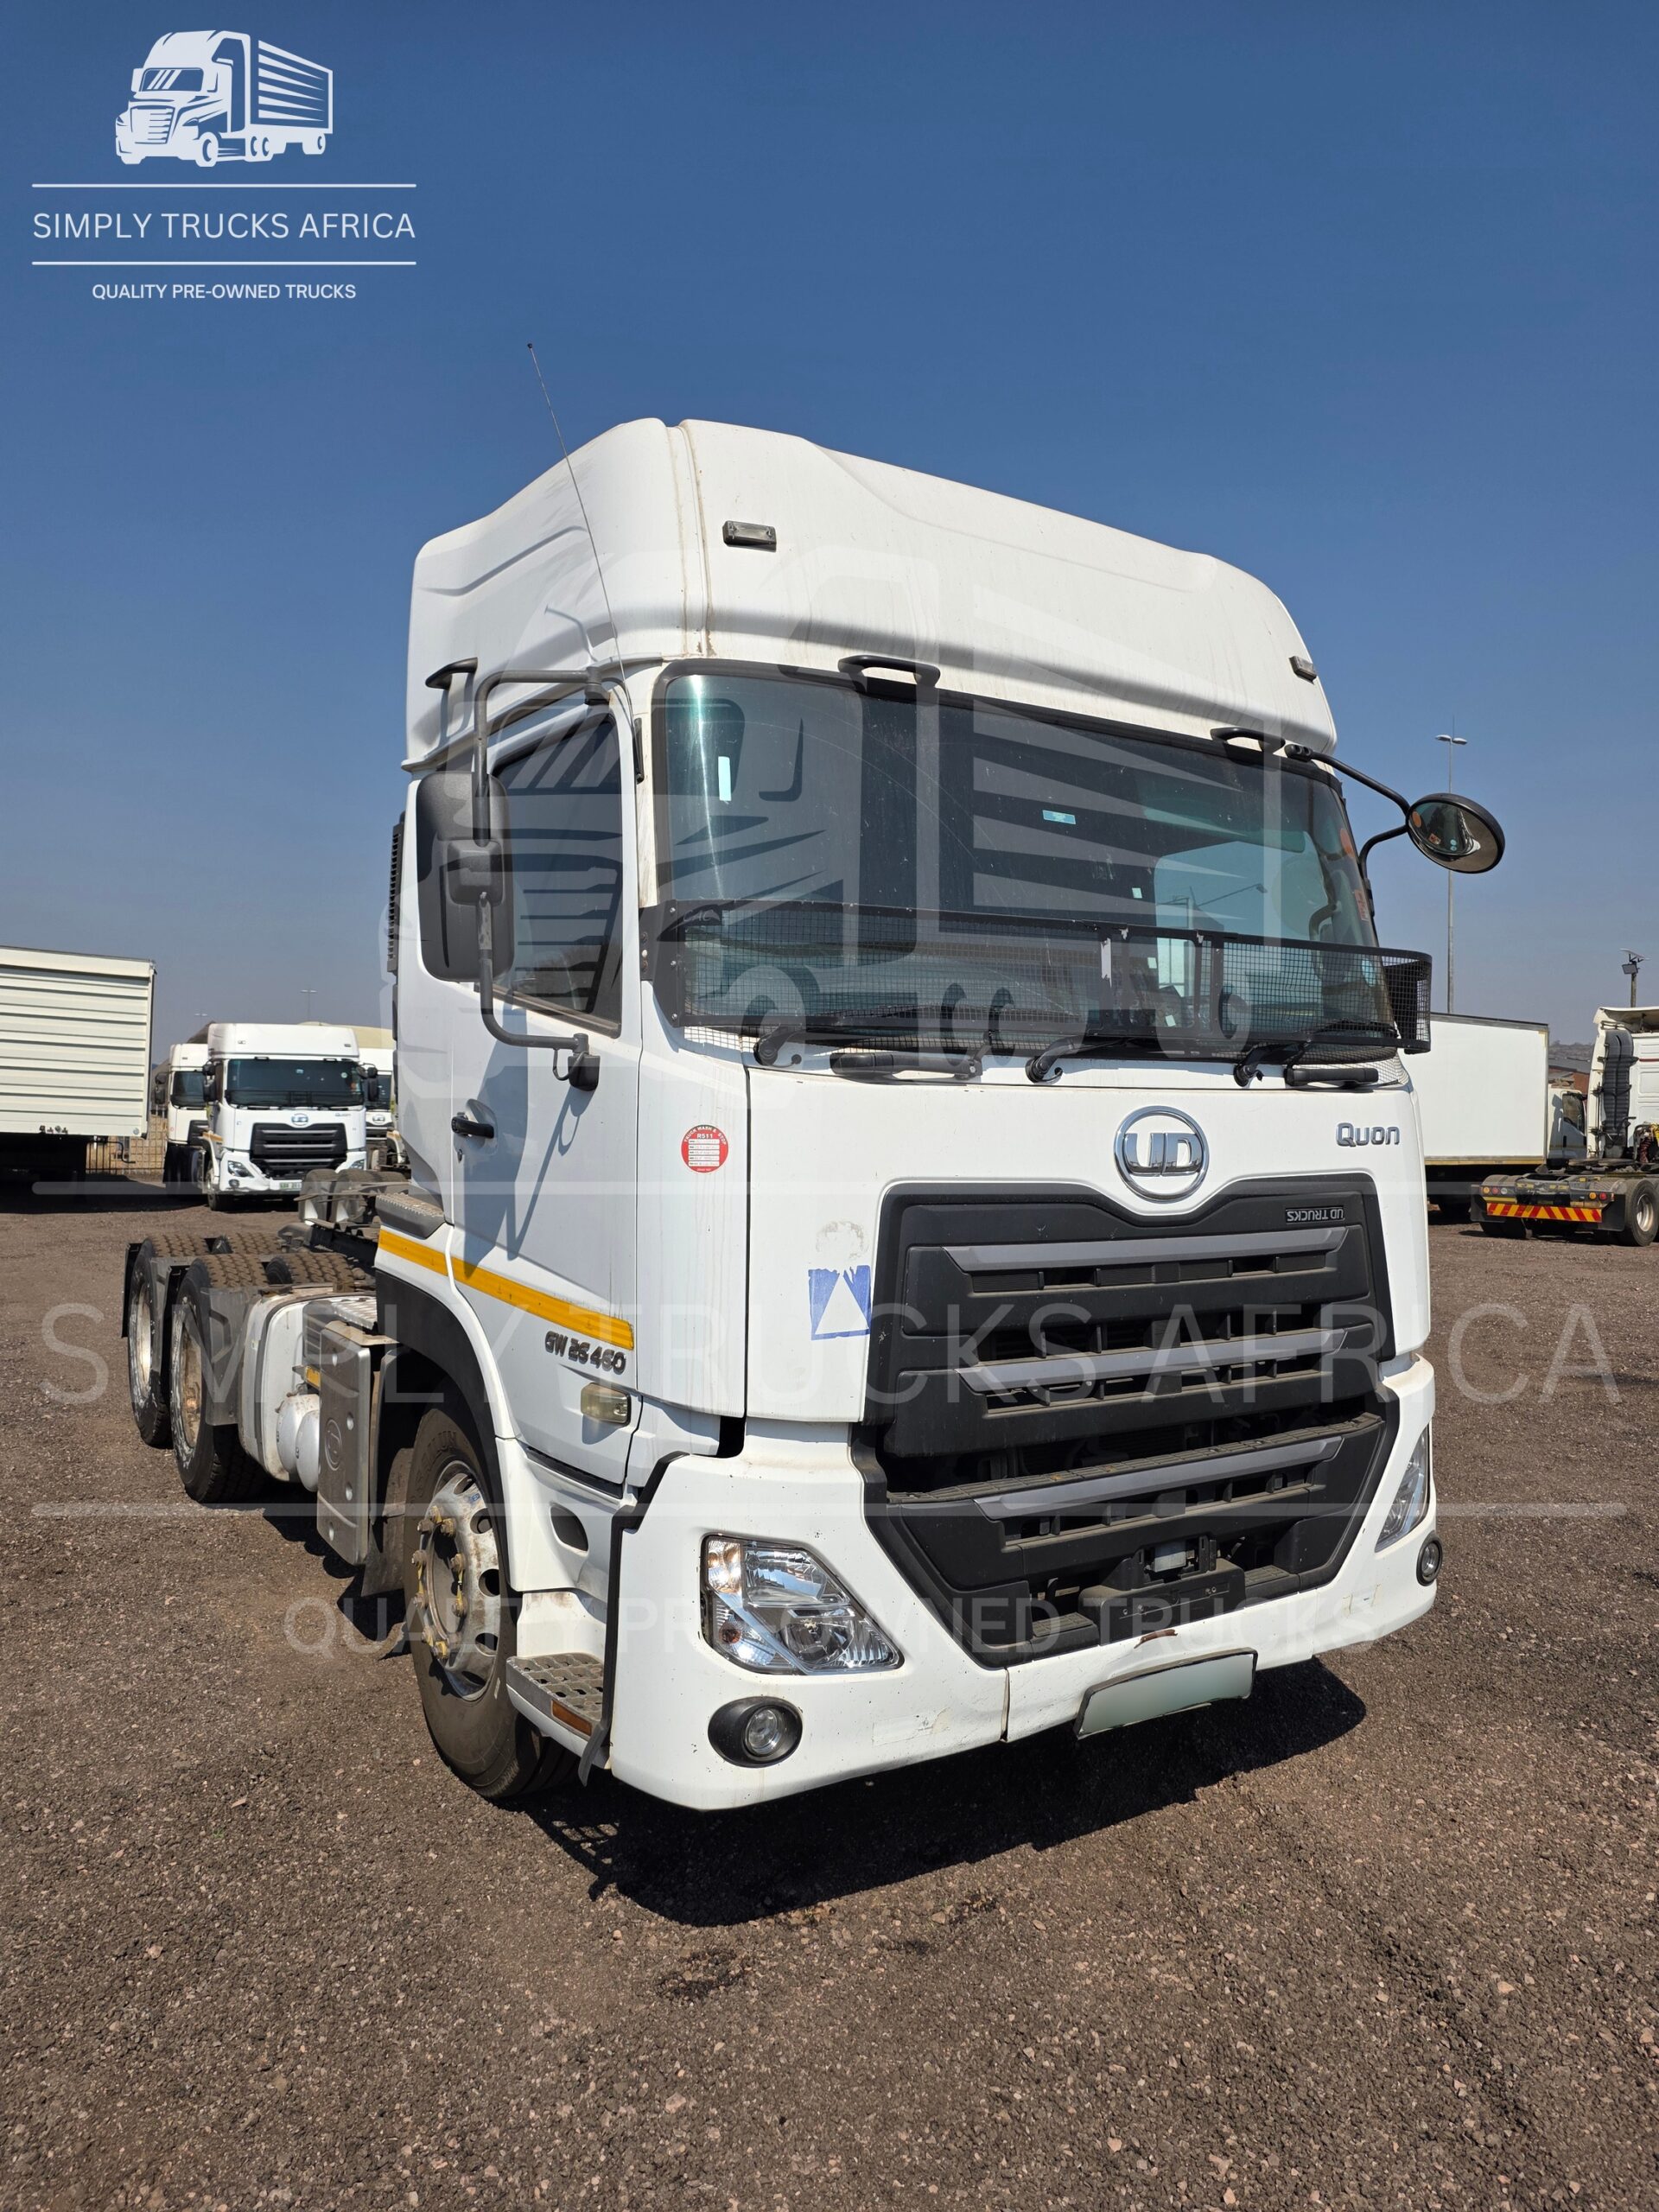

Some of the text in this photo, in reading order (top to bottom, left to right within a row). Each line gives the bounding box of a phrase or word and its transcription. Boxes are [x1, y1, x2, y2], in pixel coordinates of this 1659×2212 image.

[1336, 1122, 1400, 1147] Quon
[1123, 1132, 1204, 1177] UD
[1287, 1208, 1344, 1222] UD TRUCKS
[544, 1331, 627, 1376] GW 26 460
